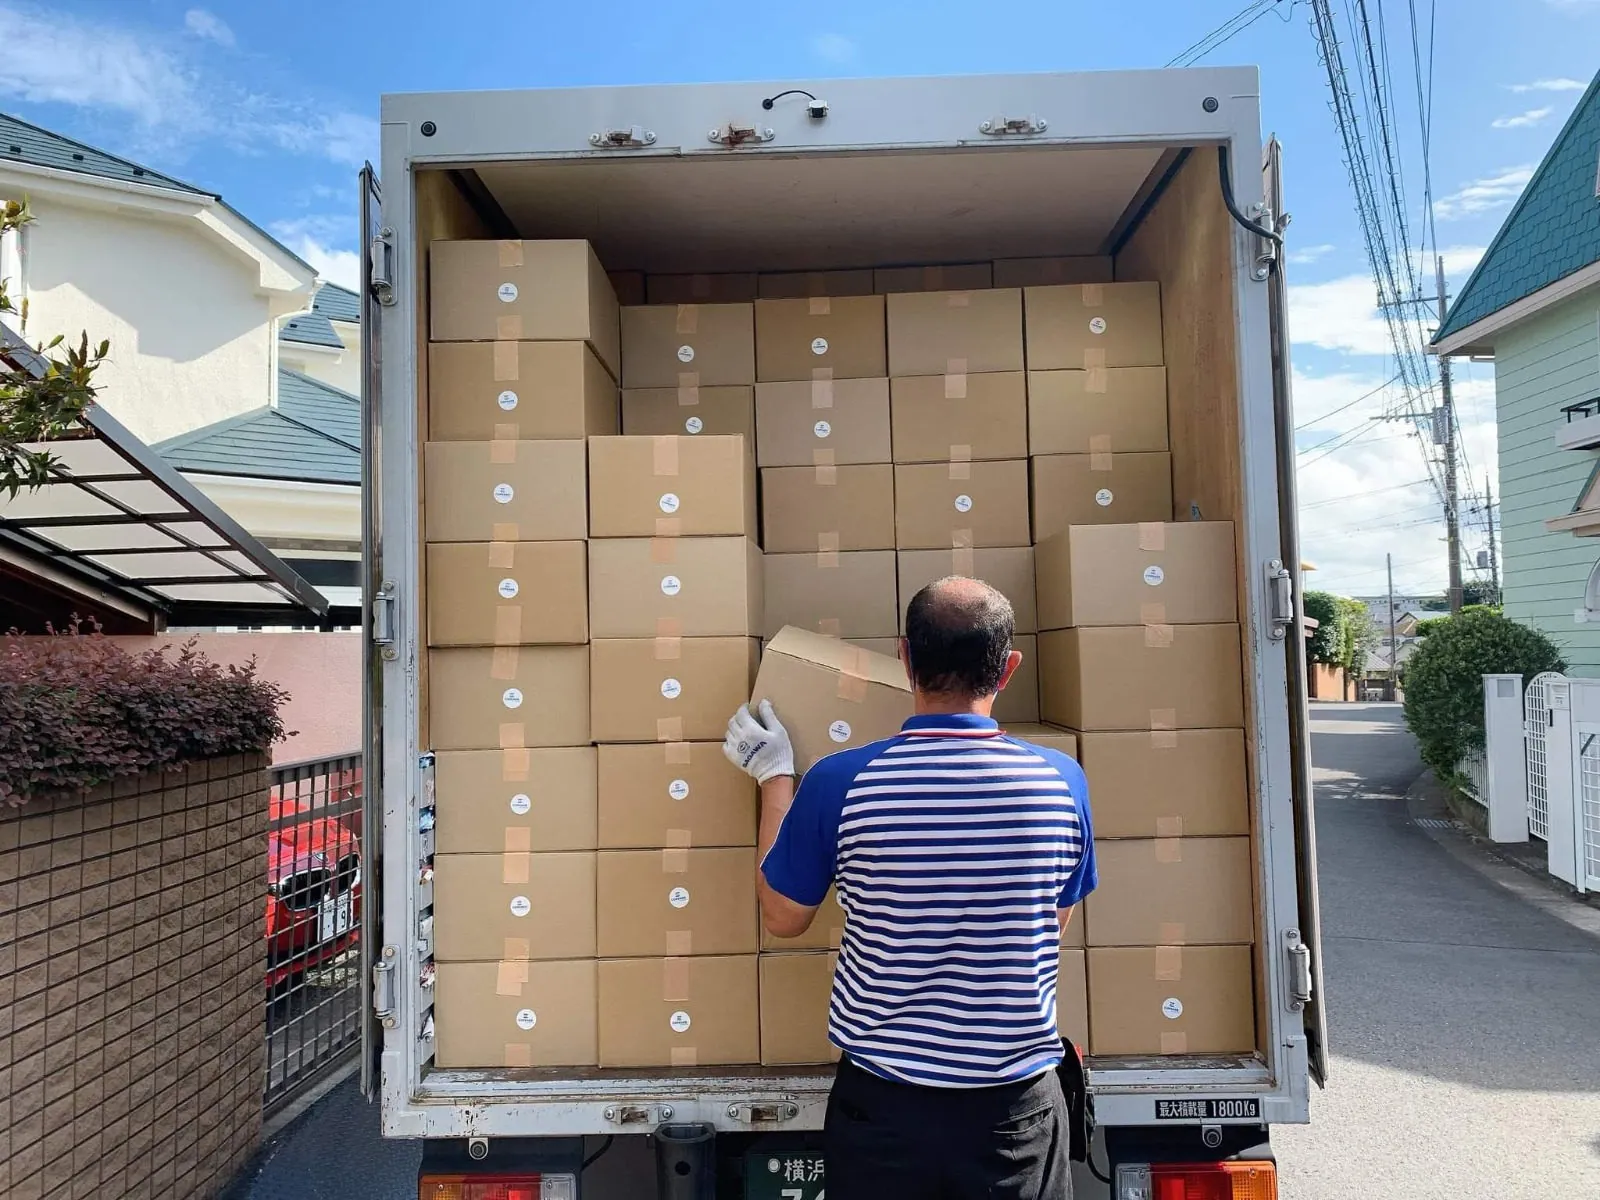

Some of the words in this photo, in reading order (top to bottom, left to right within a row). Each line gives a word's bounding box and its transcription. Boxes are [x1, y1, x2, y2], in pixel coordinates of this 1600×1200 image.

[742, 741, 767, 769] SAGAWA
[1159, 1101, 1207, 1117] 最大積載量
[784, 1159, 825, 1182] 横浜
